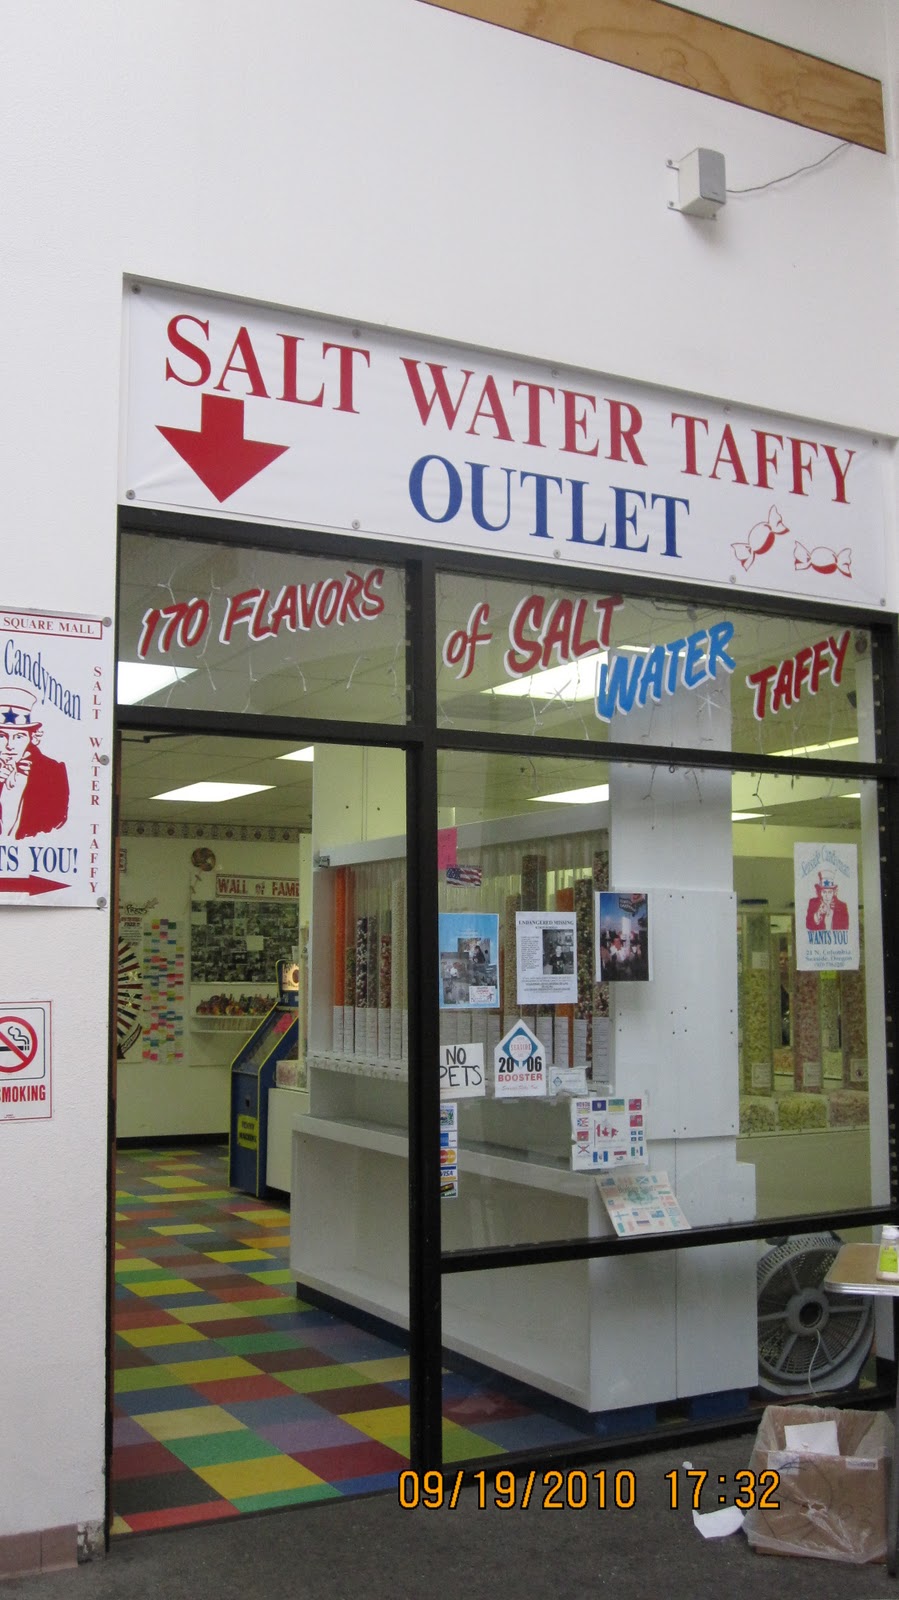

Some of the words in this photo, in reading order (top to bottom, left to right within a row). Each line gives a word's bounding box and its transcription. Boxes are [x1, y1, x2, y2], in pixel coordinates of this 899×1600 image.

[165, 313, 371, 415] SALT
[400, 356, 648, 467] WATER
[671, 411, 857, 505] TAFFY
[408, 453, 690, 559] OUTLET
[3, 616, 54, 631] SQUARE
[58, 621, 95, 635] MALL
[137, 597, 210, 660] 170
[219, 568, 386, 645] FLAVORS
[442, 601, 493, 680] of
[503, 594, 625, 679] SALT
[4, 638, 82, 721] Candyman
[91, 665, 103, 720] SALT
[594, 620, 738, 723] WATER
[746, 630, 851, 722] TAFFY
[89, 736, 103, 806] WATER
[28, 845, 78, 873] YOU!
[88, 823, 100, 893] TAFFY
[217, 878, 248, 894] WALL
[807, 930, 832, 945] WANTS
[833, 930, 849, 945] YOU
[440, 1064, 483, 1087] PETS
[446, 1046, 467, 1065] NO
[497, 1073, 543, 1083] BOOSTER
[0, 1085, 46, 1102] MOKING
